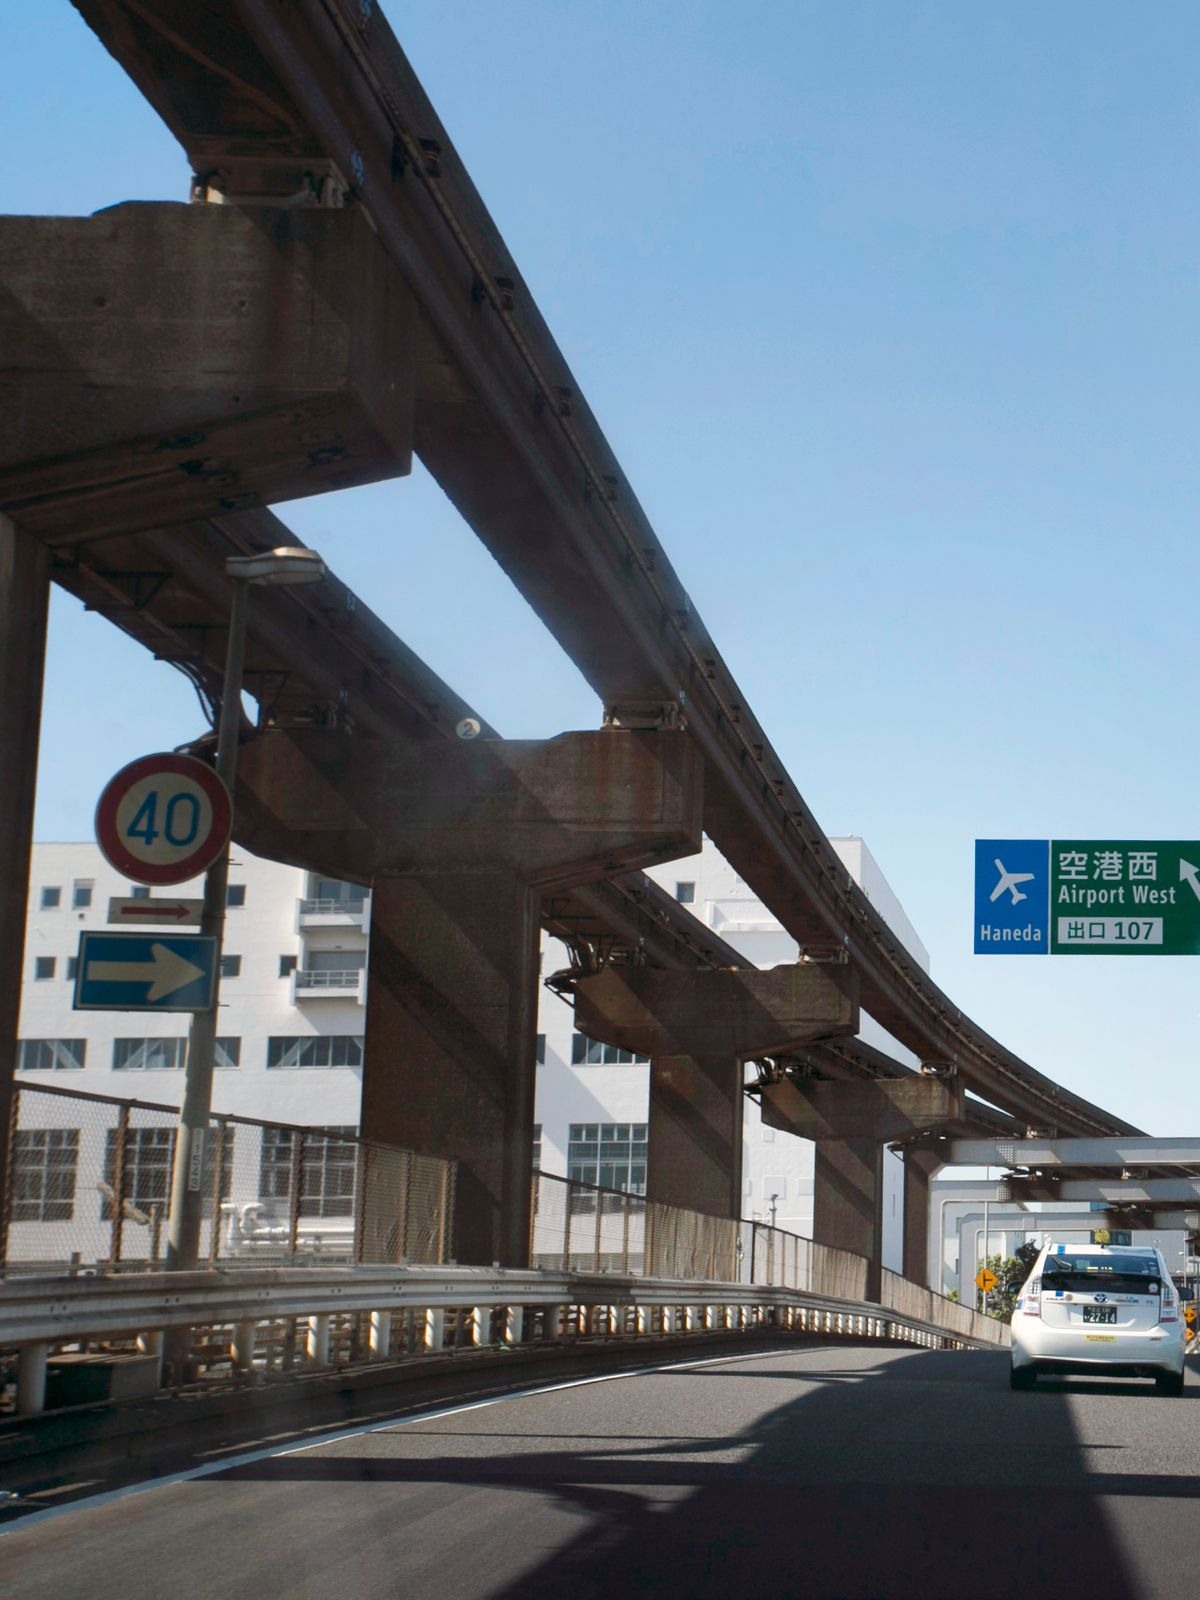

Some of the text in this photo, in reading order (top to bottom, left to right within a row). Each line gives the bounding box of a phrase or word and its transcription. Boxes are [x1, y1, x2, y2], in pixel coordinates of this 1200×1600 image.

[462, 721, 474, 737] 2
[127, 790, 201, 847] 40
[1058, 850, 1158, 881] 空港西
[1058, 884, 1176, 908] Airport West
[980, 924, 1042, 942] Haneda
[1067, 921, 1154, 940] 出口 107
